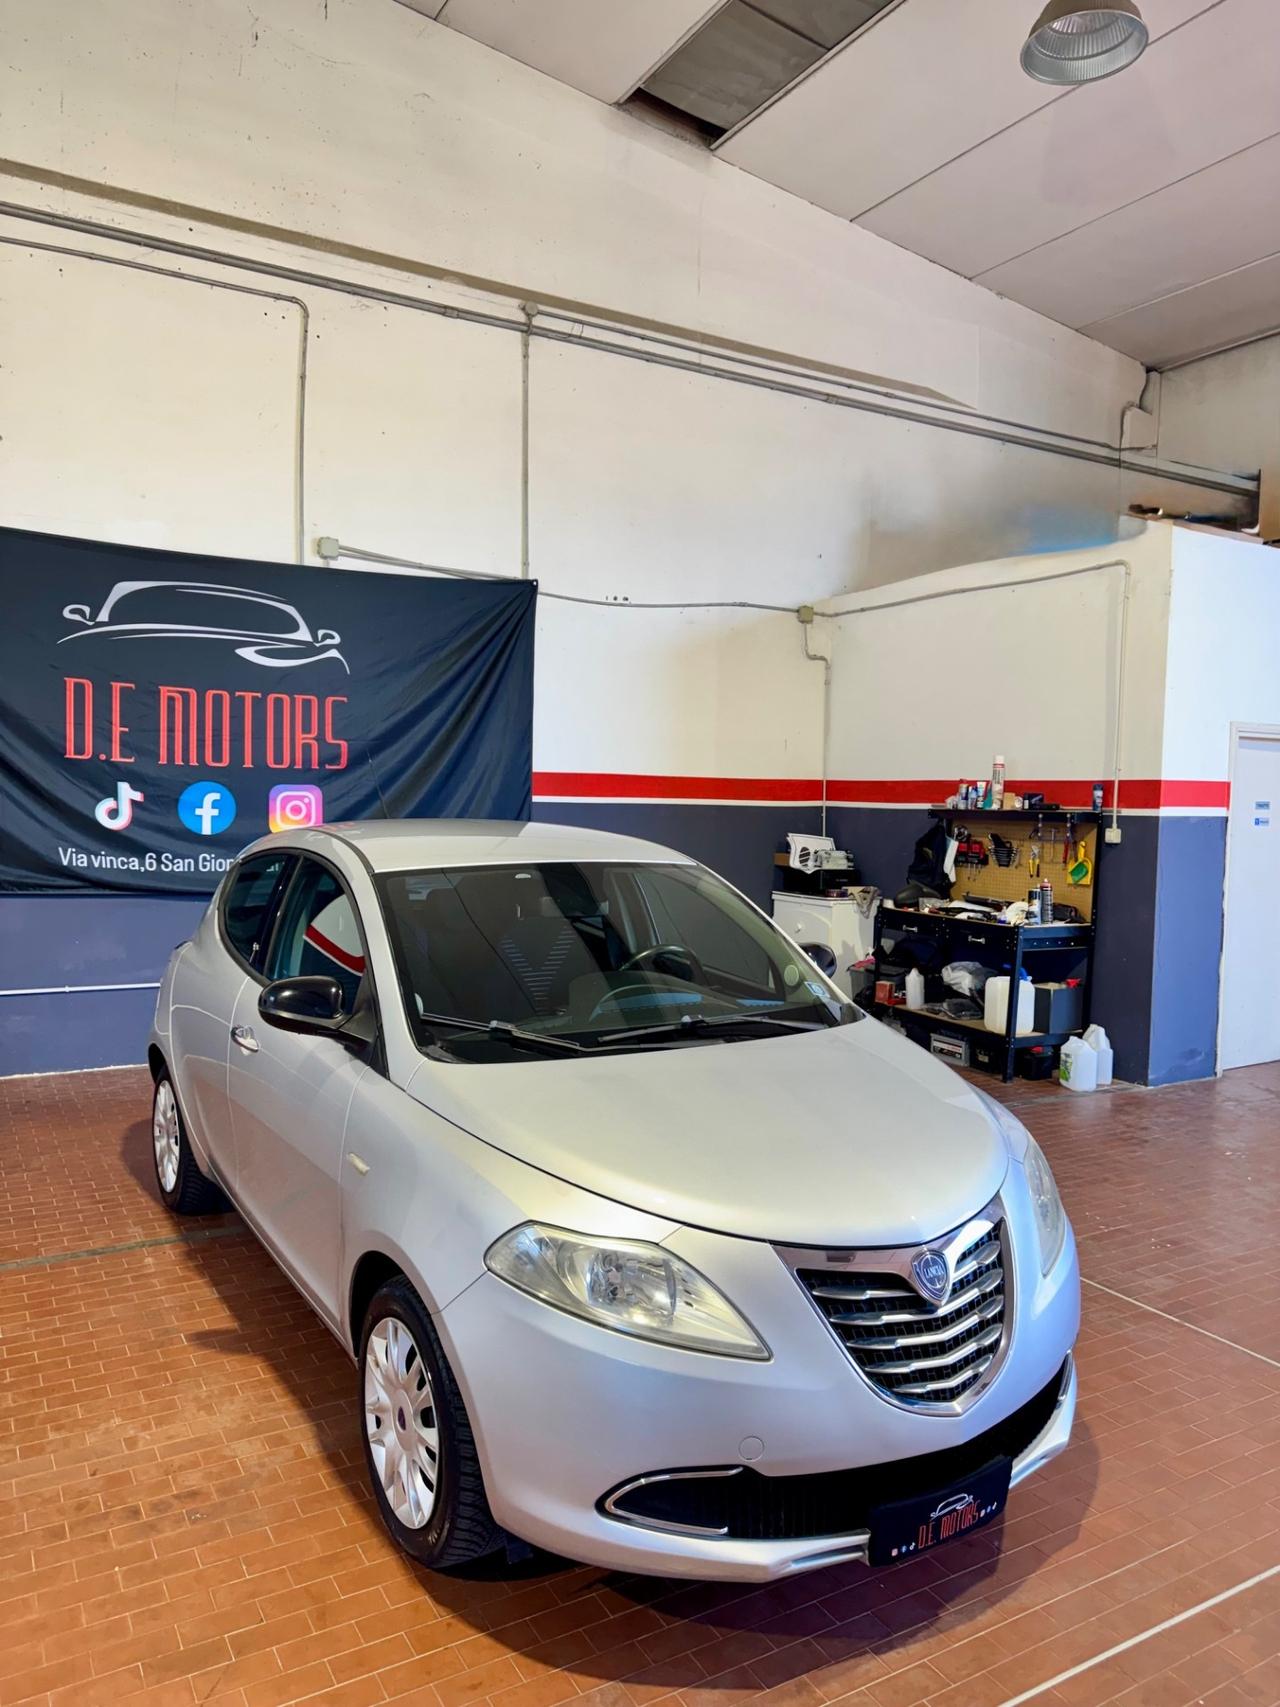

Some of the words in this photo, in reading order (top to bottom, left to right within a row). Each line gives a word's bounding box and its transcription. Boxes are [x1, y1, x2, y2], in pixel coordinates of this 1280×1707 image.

[64, 678, 135, 762] D.E
[158, 686, 348, 770] MOTORS
[58, 847, 88, 867] Via
[91, 852, 157, 872] vinca,6
[161, 853, 194, 872] San
[940, 1500, 980, 1540] MOTORS
